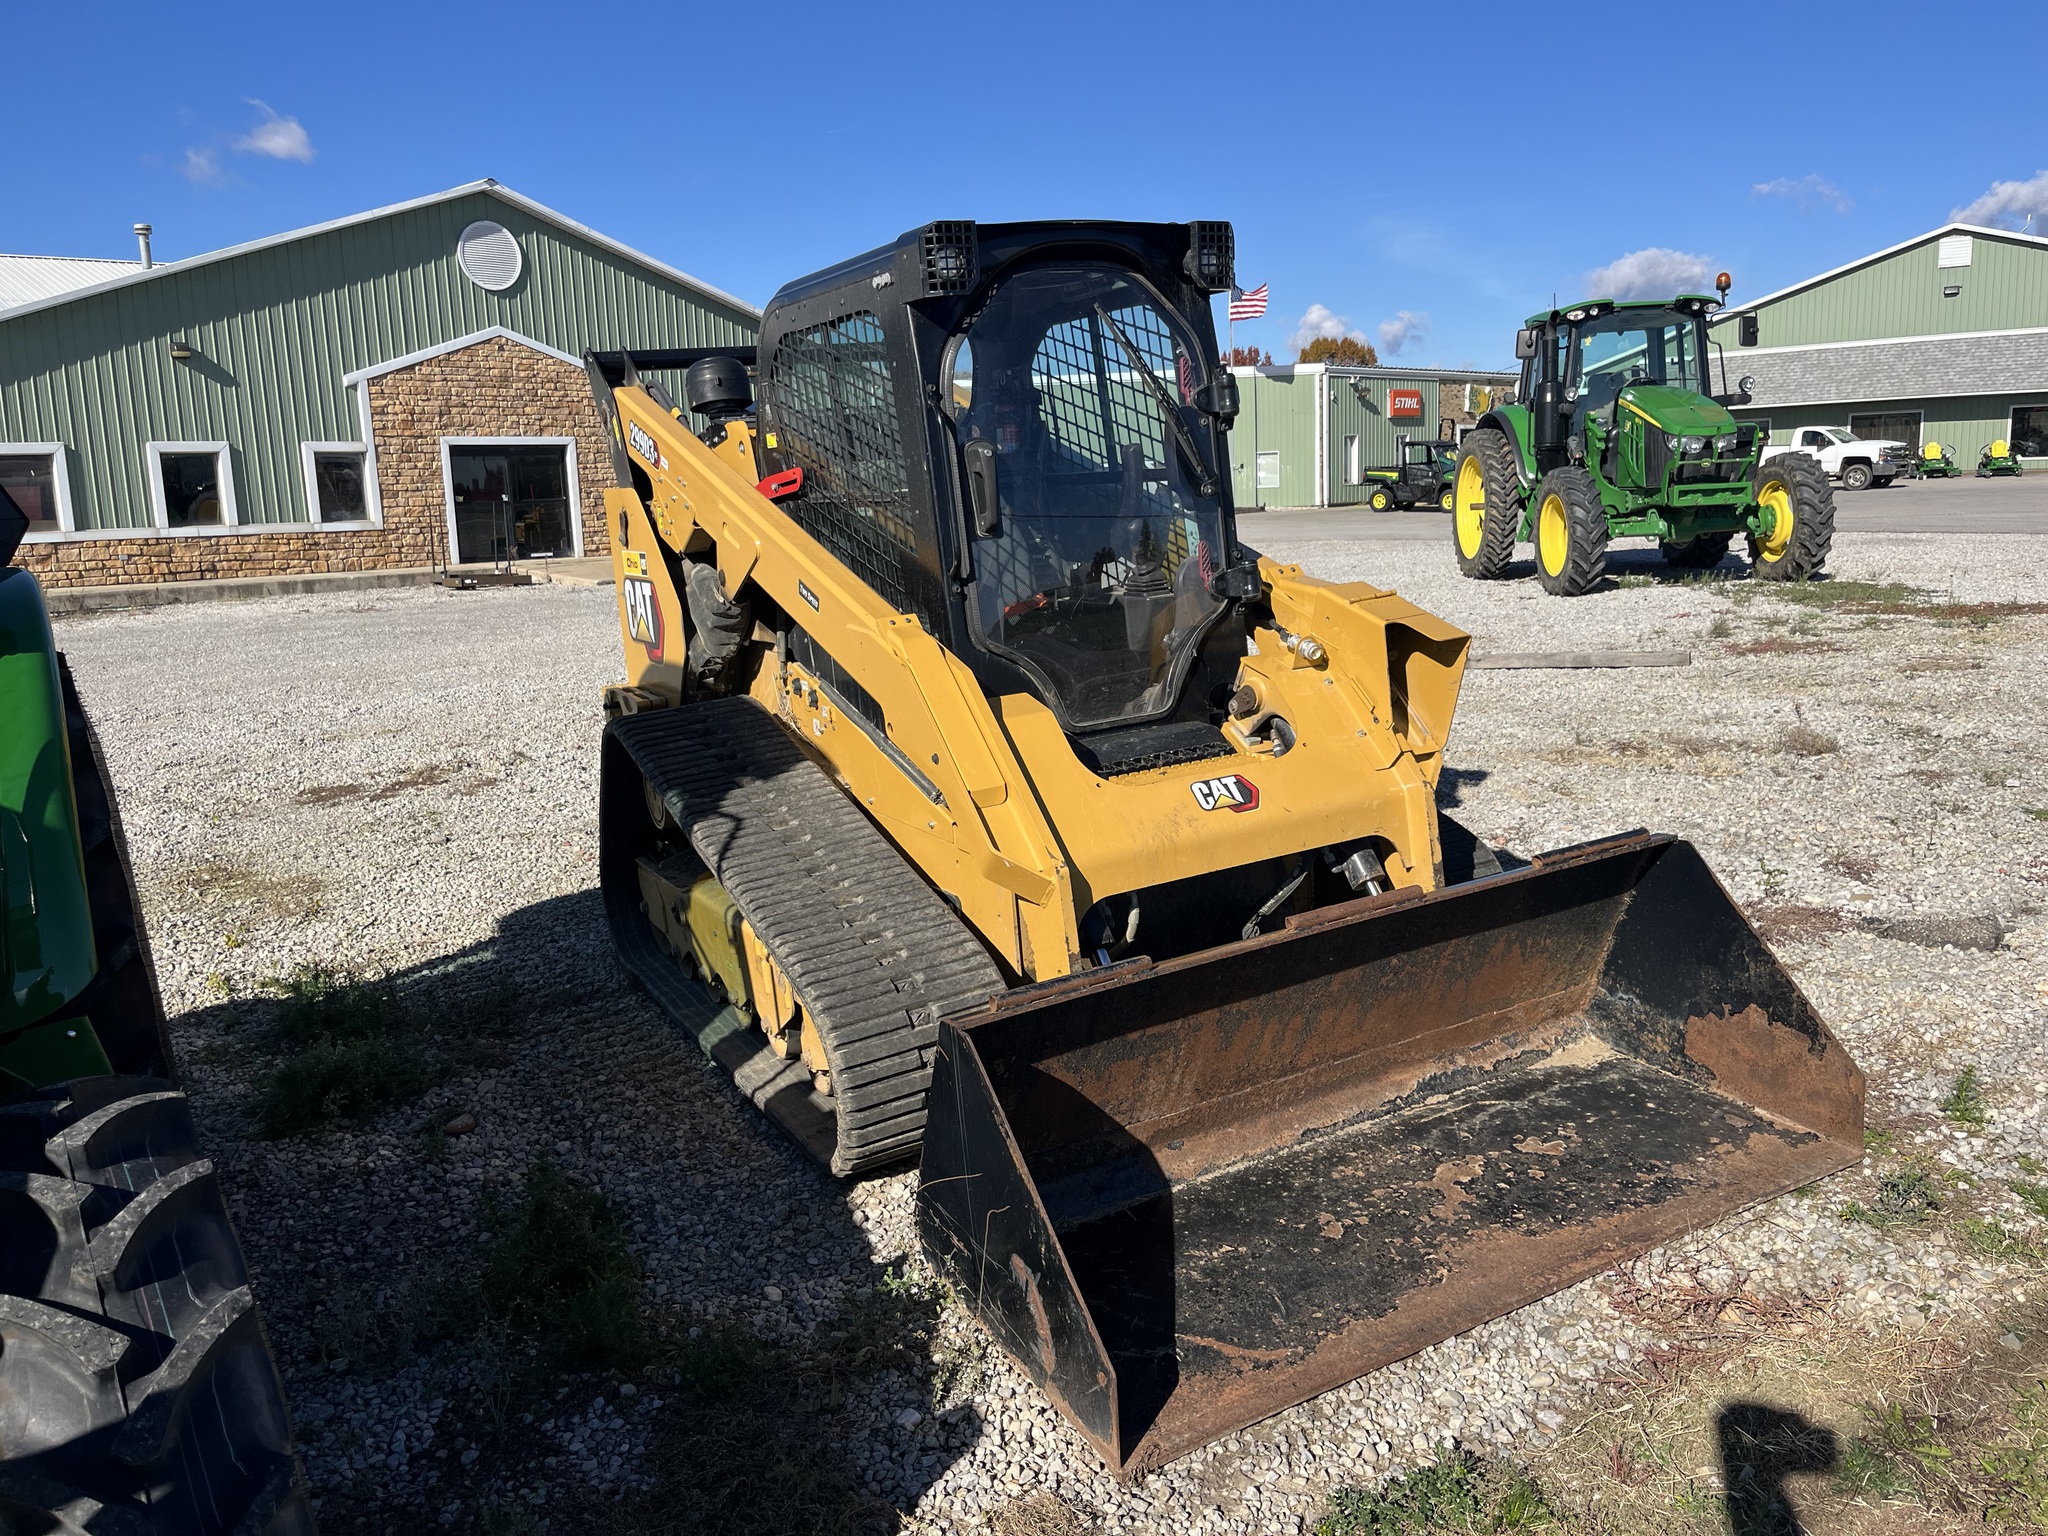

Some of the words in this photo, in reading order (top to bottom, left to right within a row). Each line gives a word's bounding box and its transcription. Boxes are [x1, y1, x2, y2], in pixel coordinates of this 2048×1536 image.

[1394, 397, 1420, 409] STIHL
[629, 420, 655, 464] 299D3
[626, 557, 638, 569] Ohio
[624, 578, 656, 644] CAT
[1191, 775, 1245, 810] CAT
